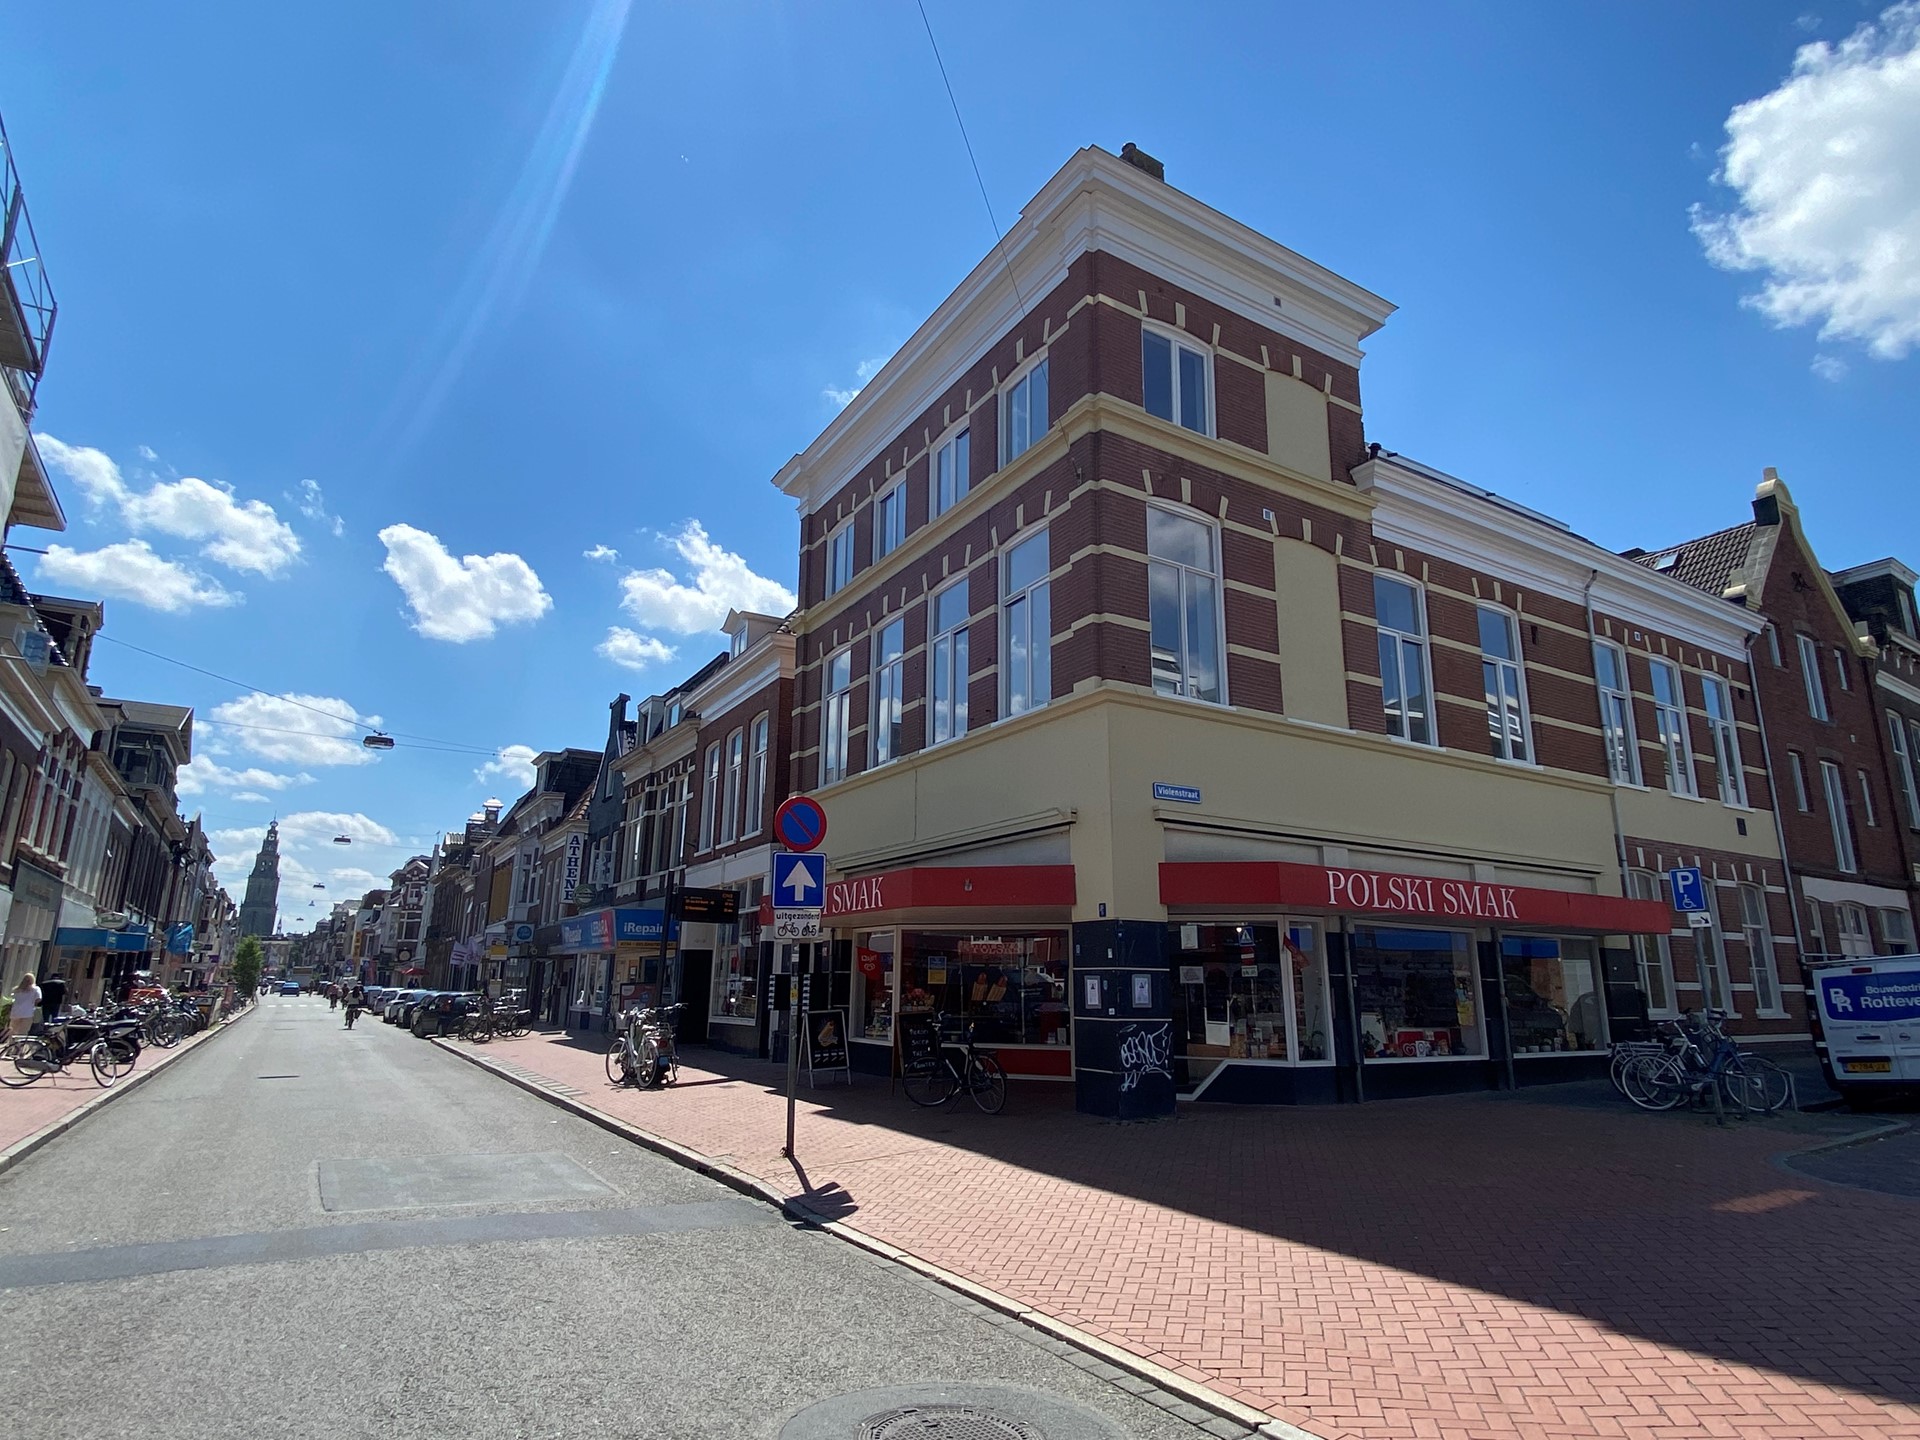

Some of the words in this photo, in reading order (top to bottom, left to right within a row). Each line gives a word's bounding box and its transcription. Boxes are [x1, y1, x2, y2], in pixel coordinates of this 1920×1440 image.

[1157, 786, 1199, 799] Violenstraat
[564, 835, 580, 901] ATHENE
[1676, 871, 1694, 894] P
[832, 877, 884, 914] SMAK
[1326, 870, 1435, 912] POLSKI
[1442, 882, 1519, 919] SMAK
[776, 912, 820, 921] uitgezonderd
